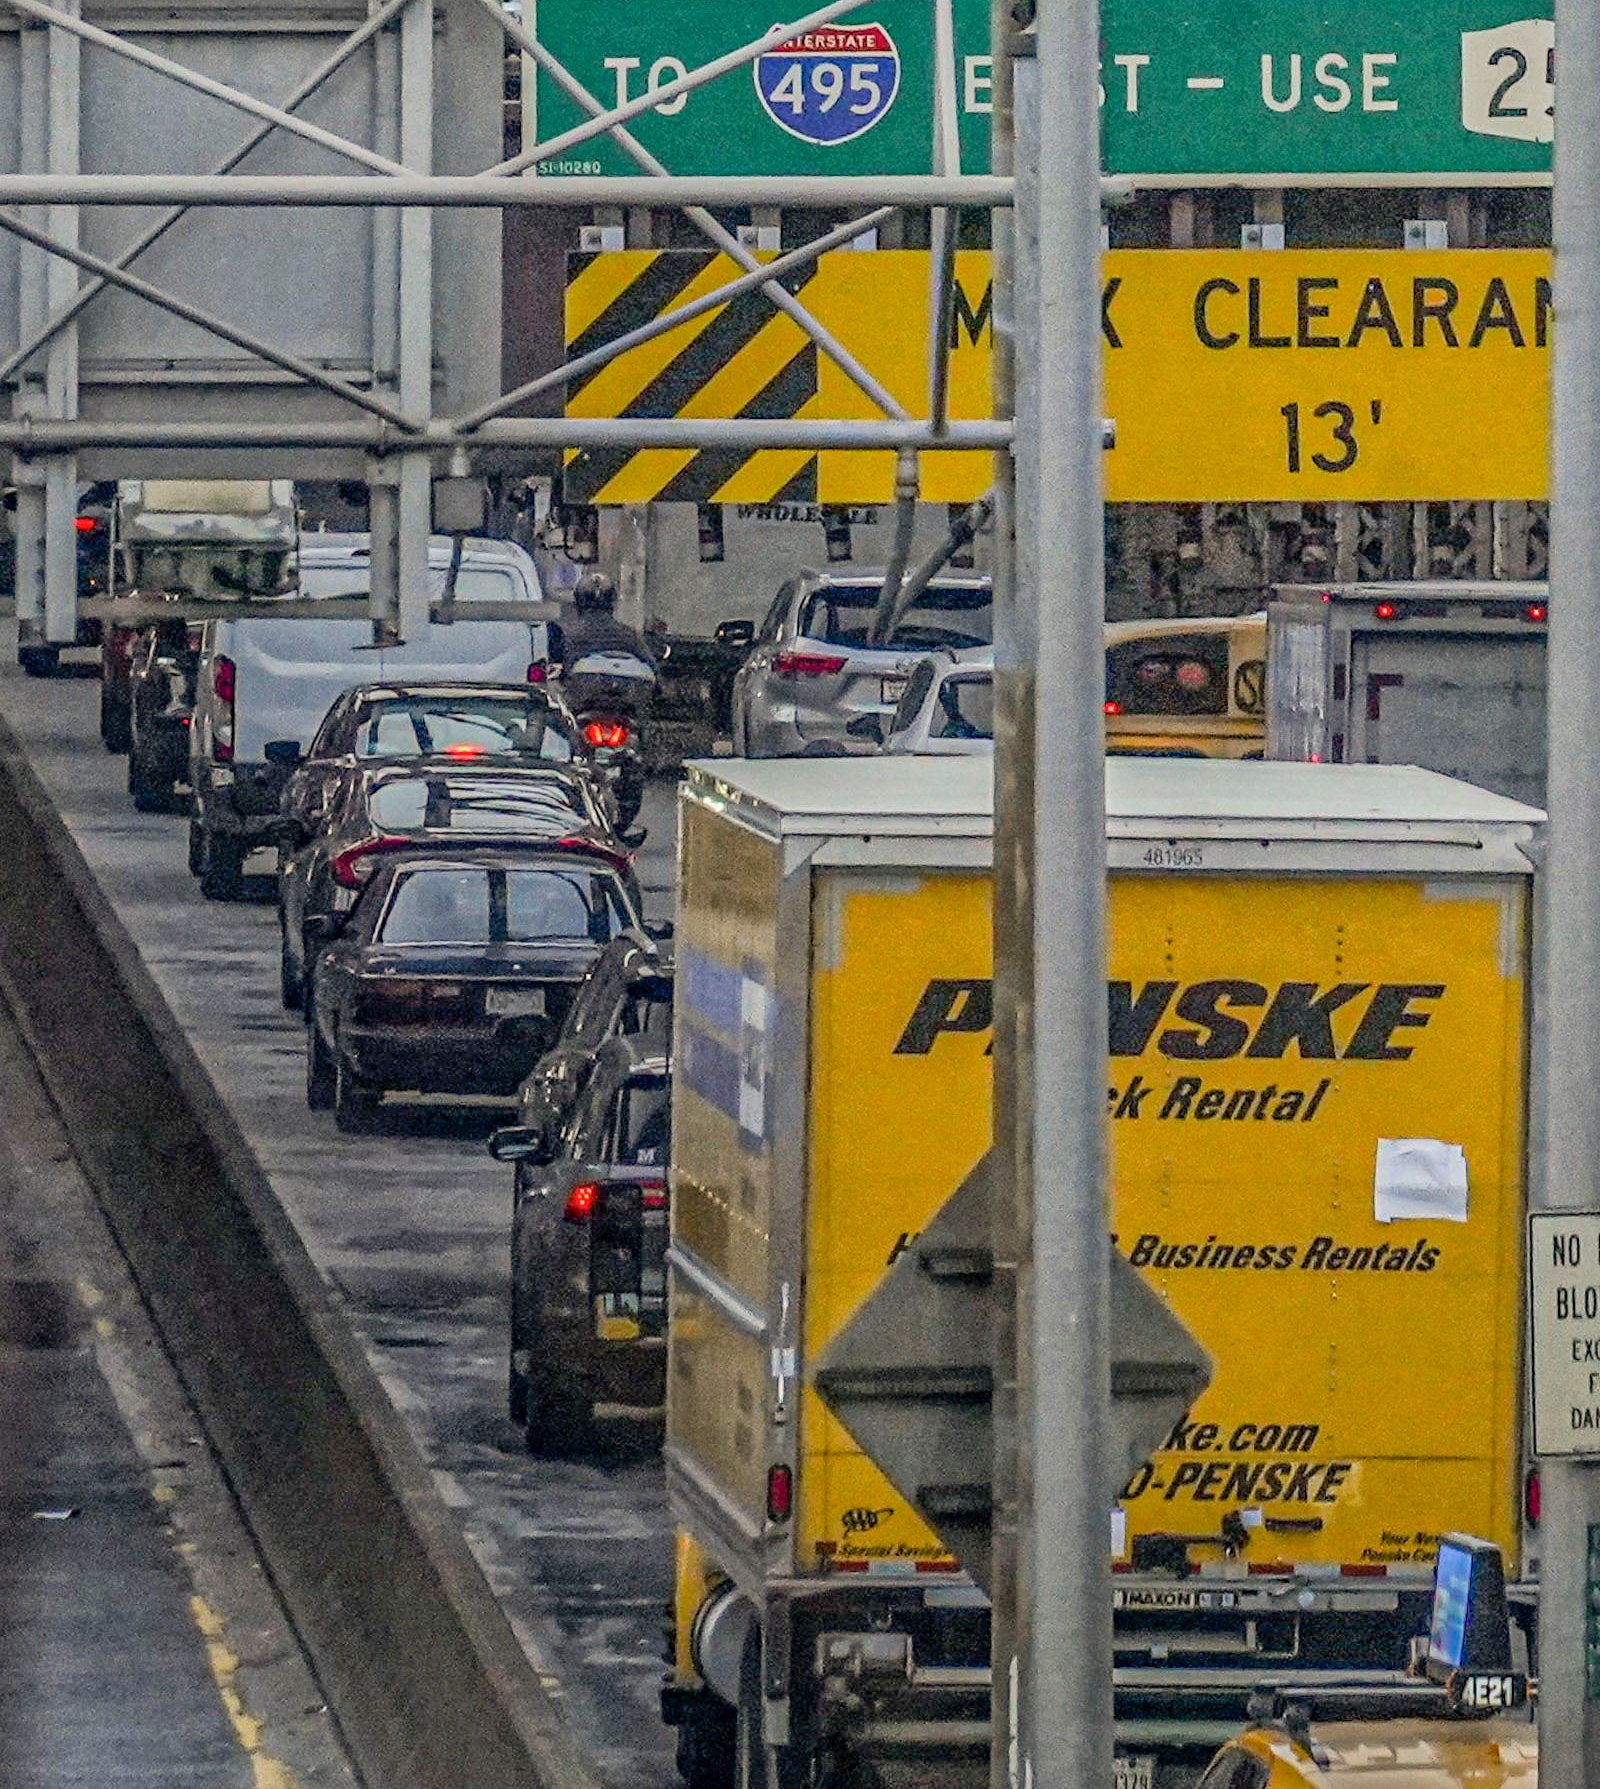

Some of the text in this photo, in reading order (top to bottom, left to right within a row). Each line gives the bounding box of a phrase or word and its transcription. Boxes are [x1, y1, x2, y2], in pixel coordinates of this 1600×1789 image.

[603, 56, 688, 116] TO
[769, 62, 881, 115] 495
[964, 53, 1150, 114] ET
[1260, 53, 1399, 113] USE
[1486, 46, 1554, 118] 2
[1280, 399, 1383, 474] 13'
[892, 978, 1447, 1061] PNSKE
[1158, 1076, 1332, 1123] Rental
[1128, 1233, 1441, 1272] Business Rentals
[1552, 1234, 1582, 1267] NO
[1128, 1590, 1191, 1607] MAXON
[1461, 1675, 1514, 1707] 4E21
